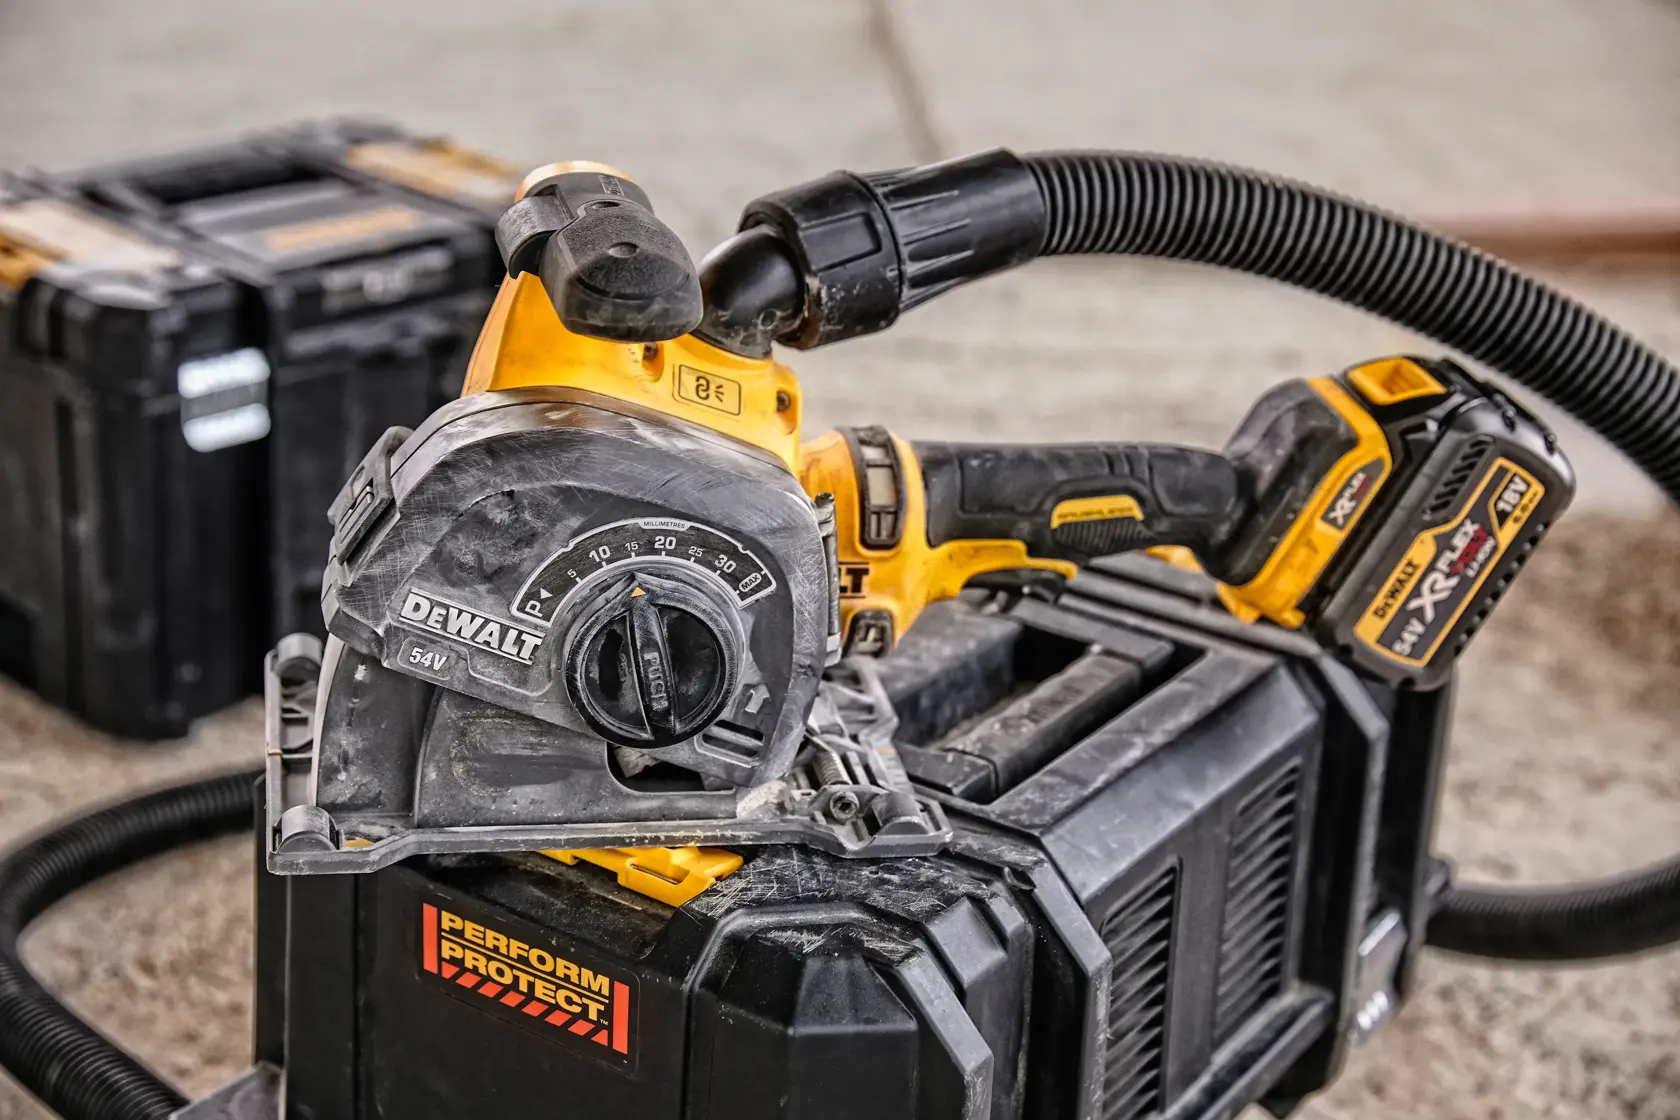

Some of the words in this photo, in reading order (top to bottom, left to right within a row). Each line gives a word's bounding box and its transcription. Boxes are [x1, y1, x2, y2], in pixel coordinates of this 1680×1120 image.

[643, 520, 686, 529] MILLIMETRES
[525, 601, 544, 617] P
[567, 569, 577, 579] 5
[588, 545, 611, 563] 10
[624, 541, 639, 551] 15
[654, 536, 677, 549] 20
[688, 545, 703, 557] 25
[714, 554, 737, 574] 30
[741, 575, 761, 591] MAX
[409, 647, 447, 671] 54V
[441, 910, 610, 997] PERFORM
[441, 939, 605, 1022] PROTECT
